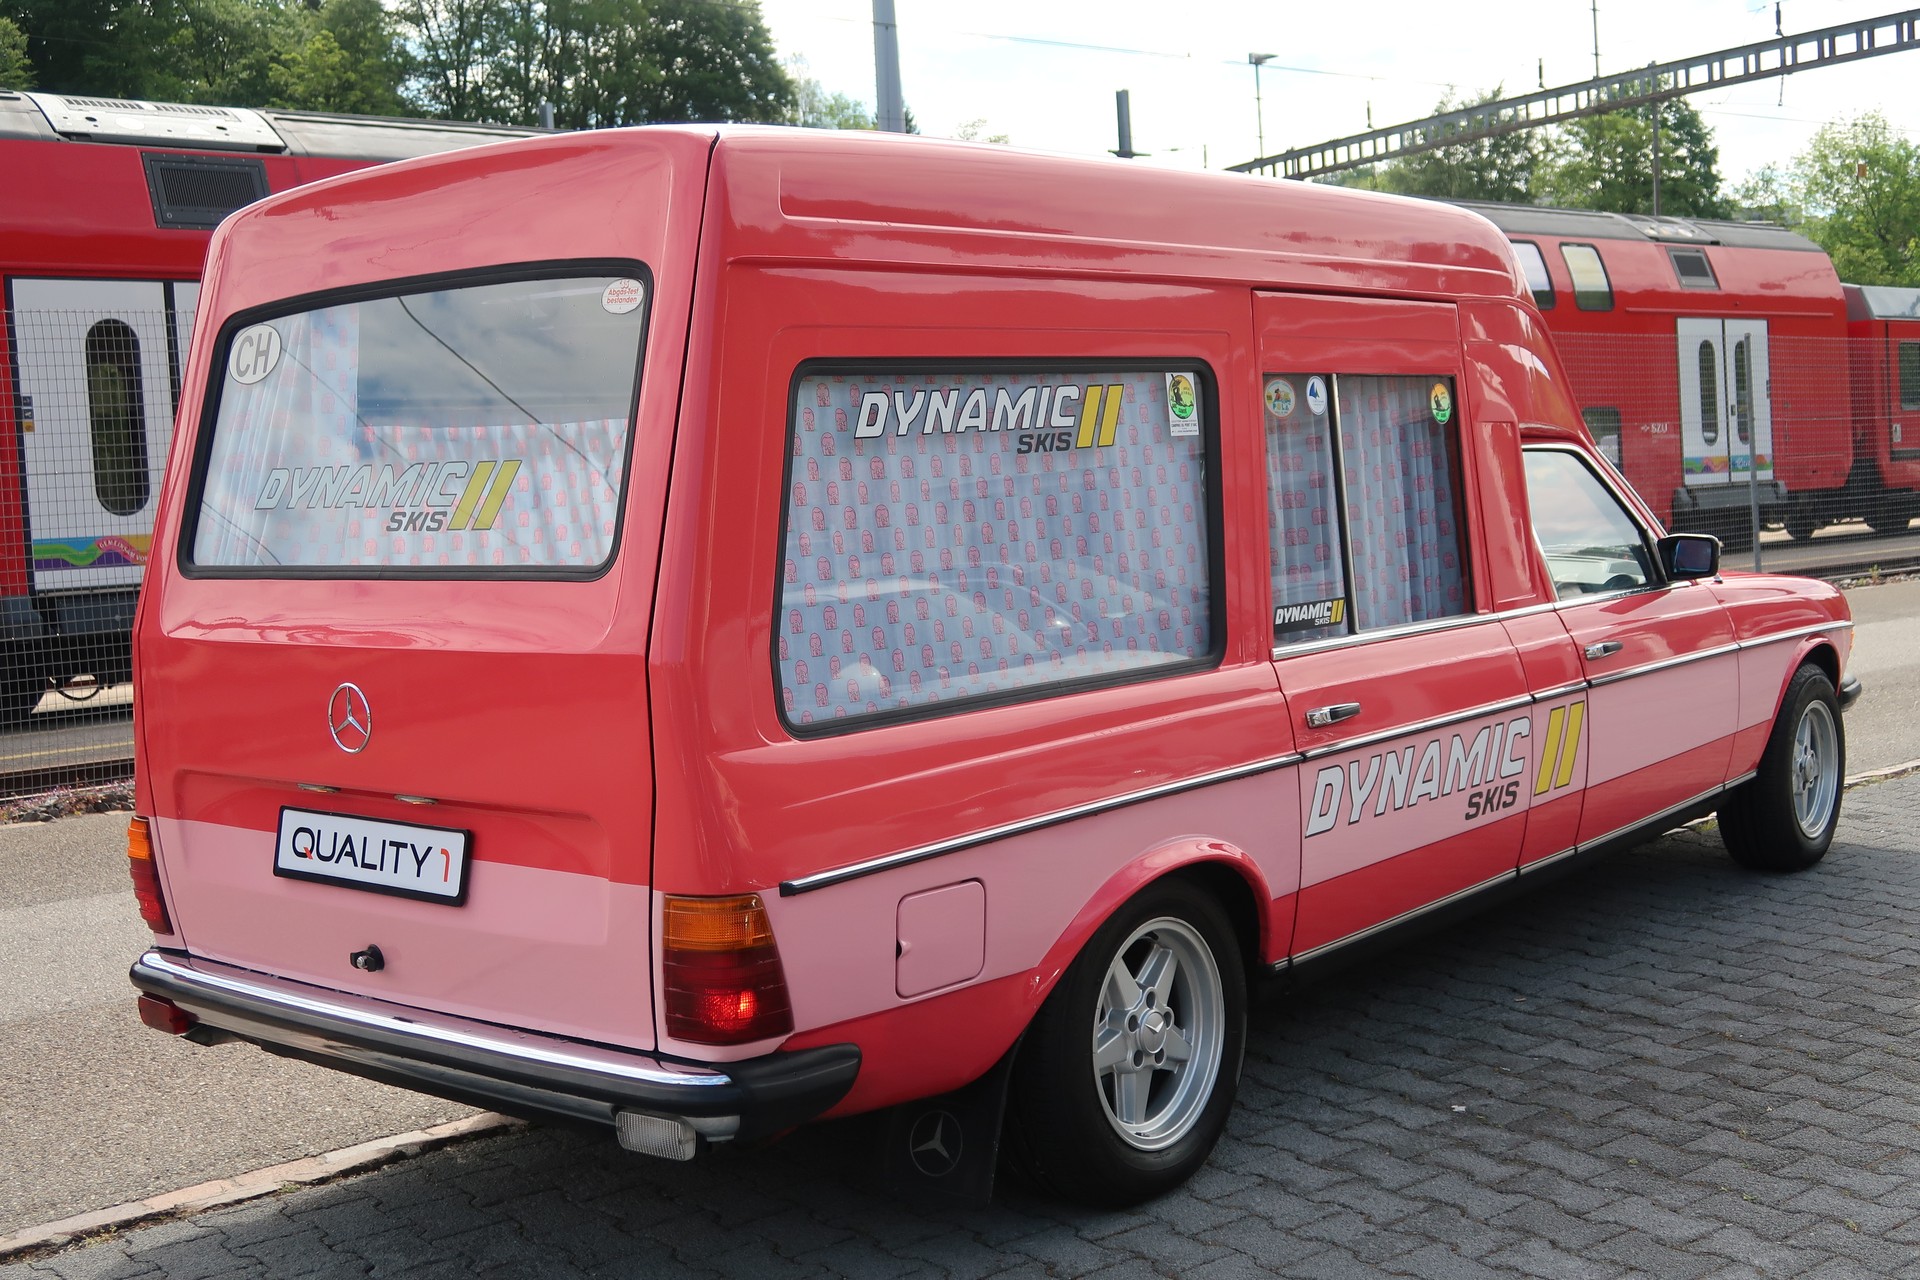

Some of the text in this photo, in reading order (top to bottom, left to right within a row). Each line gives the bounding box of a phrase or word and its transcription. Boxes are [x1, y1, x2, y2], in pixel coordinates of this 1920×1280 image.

[236, 331, 273, 378] CH
[853, 384, 1081, 439] DYNAMIC
[1016, 431, 1073, 455] SKIS
[254, 460, 470, 511] DYNAMIC
[385, 511, 448, 532] SKIS
[1275, 601, 1333, 625] DYNAMIC
[1314, 616, 1331, 626] SKIS
[1304, 715, 1532, 839] DYNAMIC
[1464, 780, 1520, 822] SKIS
